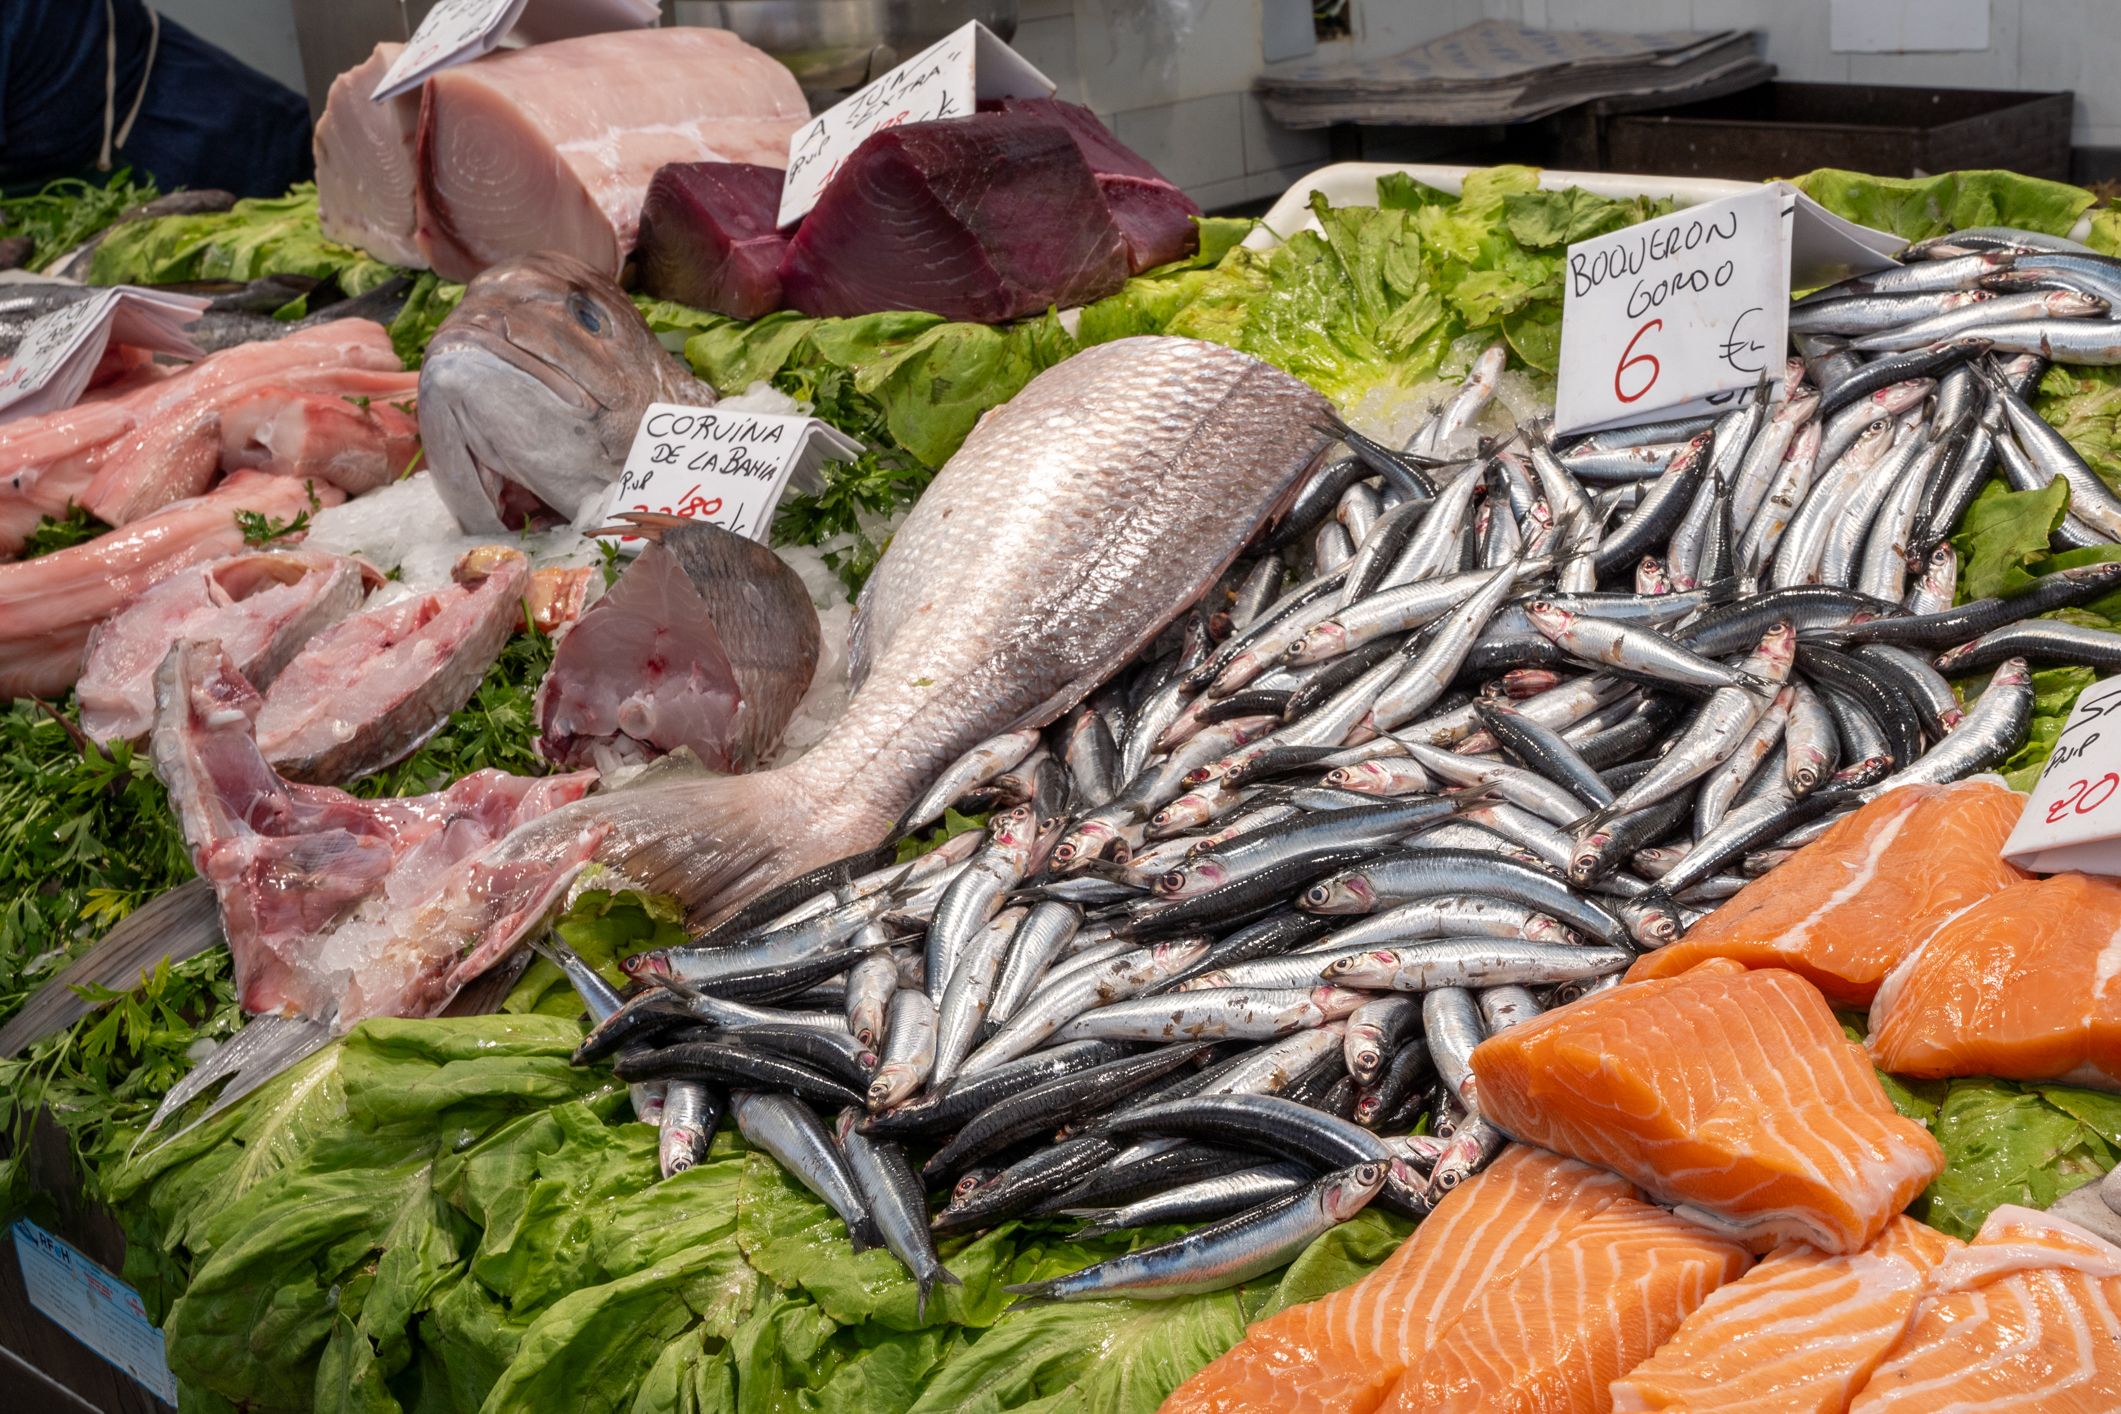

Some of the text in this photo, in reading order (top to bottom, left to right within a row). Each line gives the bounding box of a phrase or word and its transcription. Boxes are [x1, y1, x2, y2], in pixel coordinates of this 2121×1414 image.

[1570, 211, 1738, 298] BOQUERON
[1626, 259, 1734, 319] GORDO
[1613, 317, 1664, 404] 6
[650, 442, 686, 465] DE
[2045, 772, 2120, 824] 20
